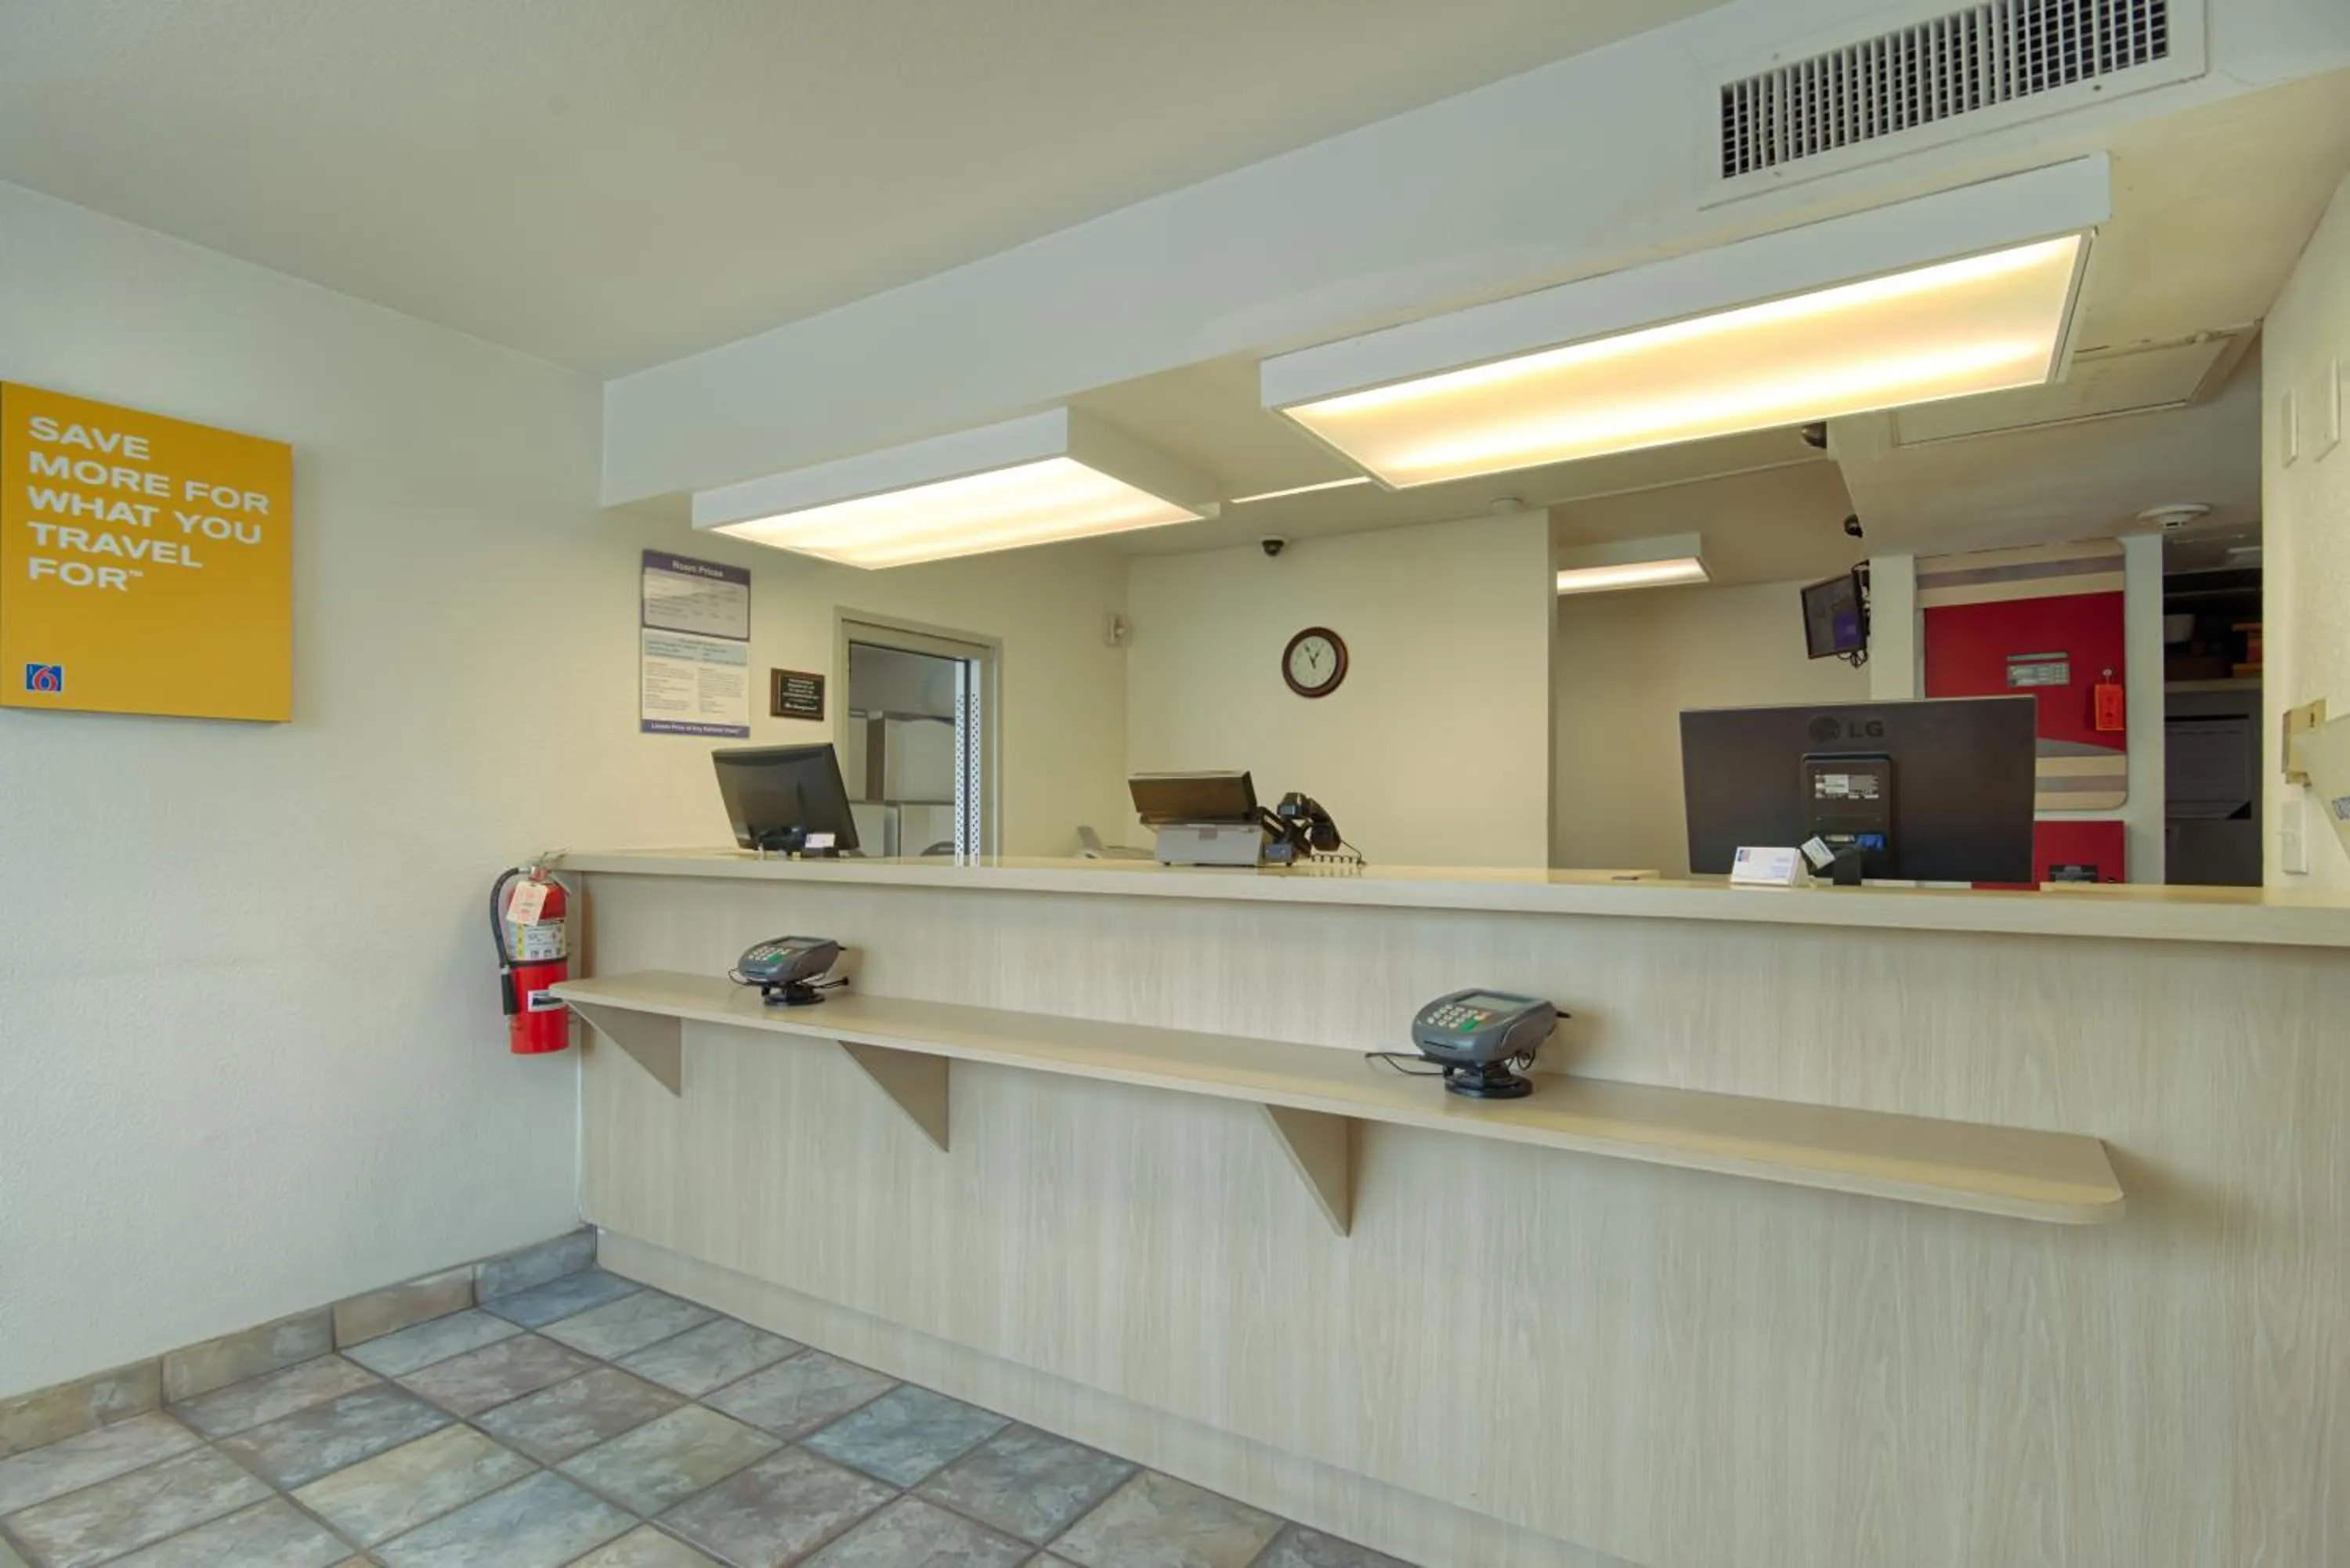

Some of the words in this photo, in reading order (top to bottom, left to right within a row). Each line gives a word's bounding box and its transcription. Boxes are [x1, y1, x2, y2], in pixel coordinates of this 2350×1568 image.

[29, 416, 150, 461] SAVE
[29, 451, 171, 497] MORE
[184, 480, 269, 515] FOR
[27, 486, 160, 527] WHAT
[173, 511, 262, 545] YOU
[27, 522, 203, 568] TRAVEL
[1849, 720, 1884, 739] LG
